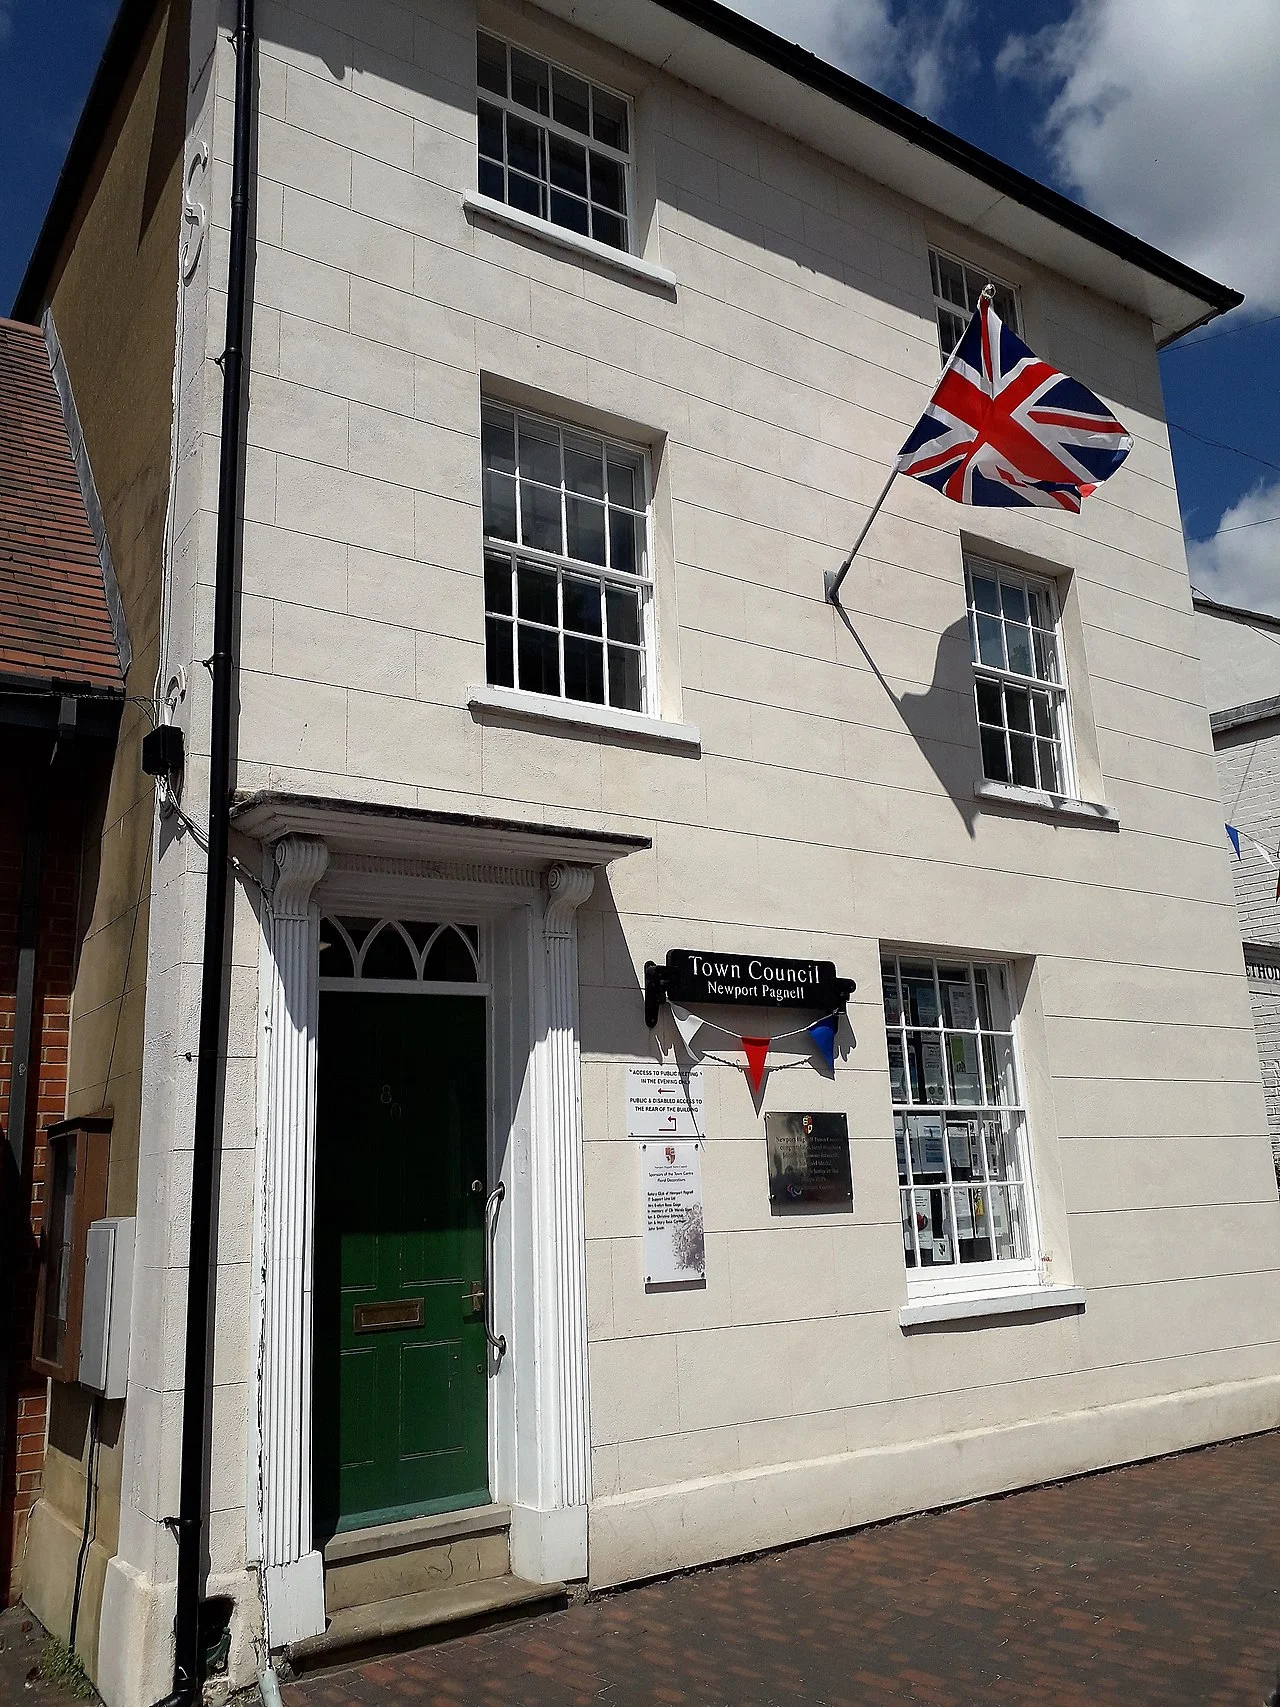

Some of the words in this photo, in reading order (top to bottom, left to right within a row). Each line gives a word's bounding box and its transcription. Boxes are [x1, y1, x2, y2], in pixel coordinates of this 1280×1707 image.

[688, 955, 741, 979] Town
[748, 960, 820, 984] Council
[707, 980, 758, 999] Newport
[762, 984, 805, 1001] Pagnell
